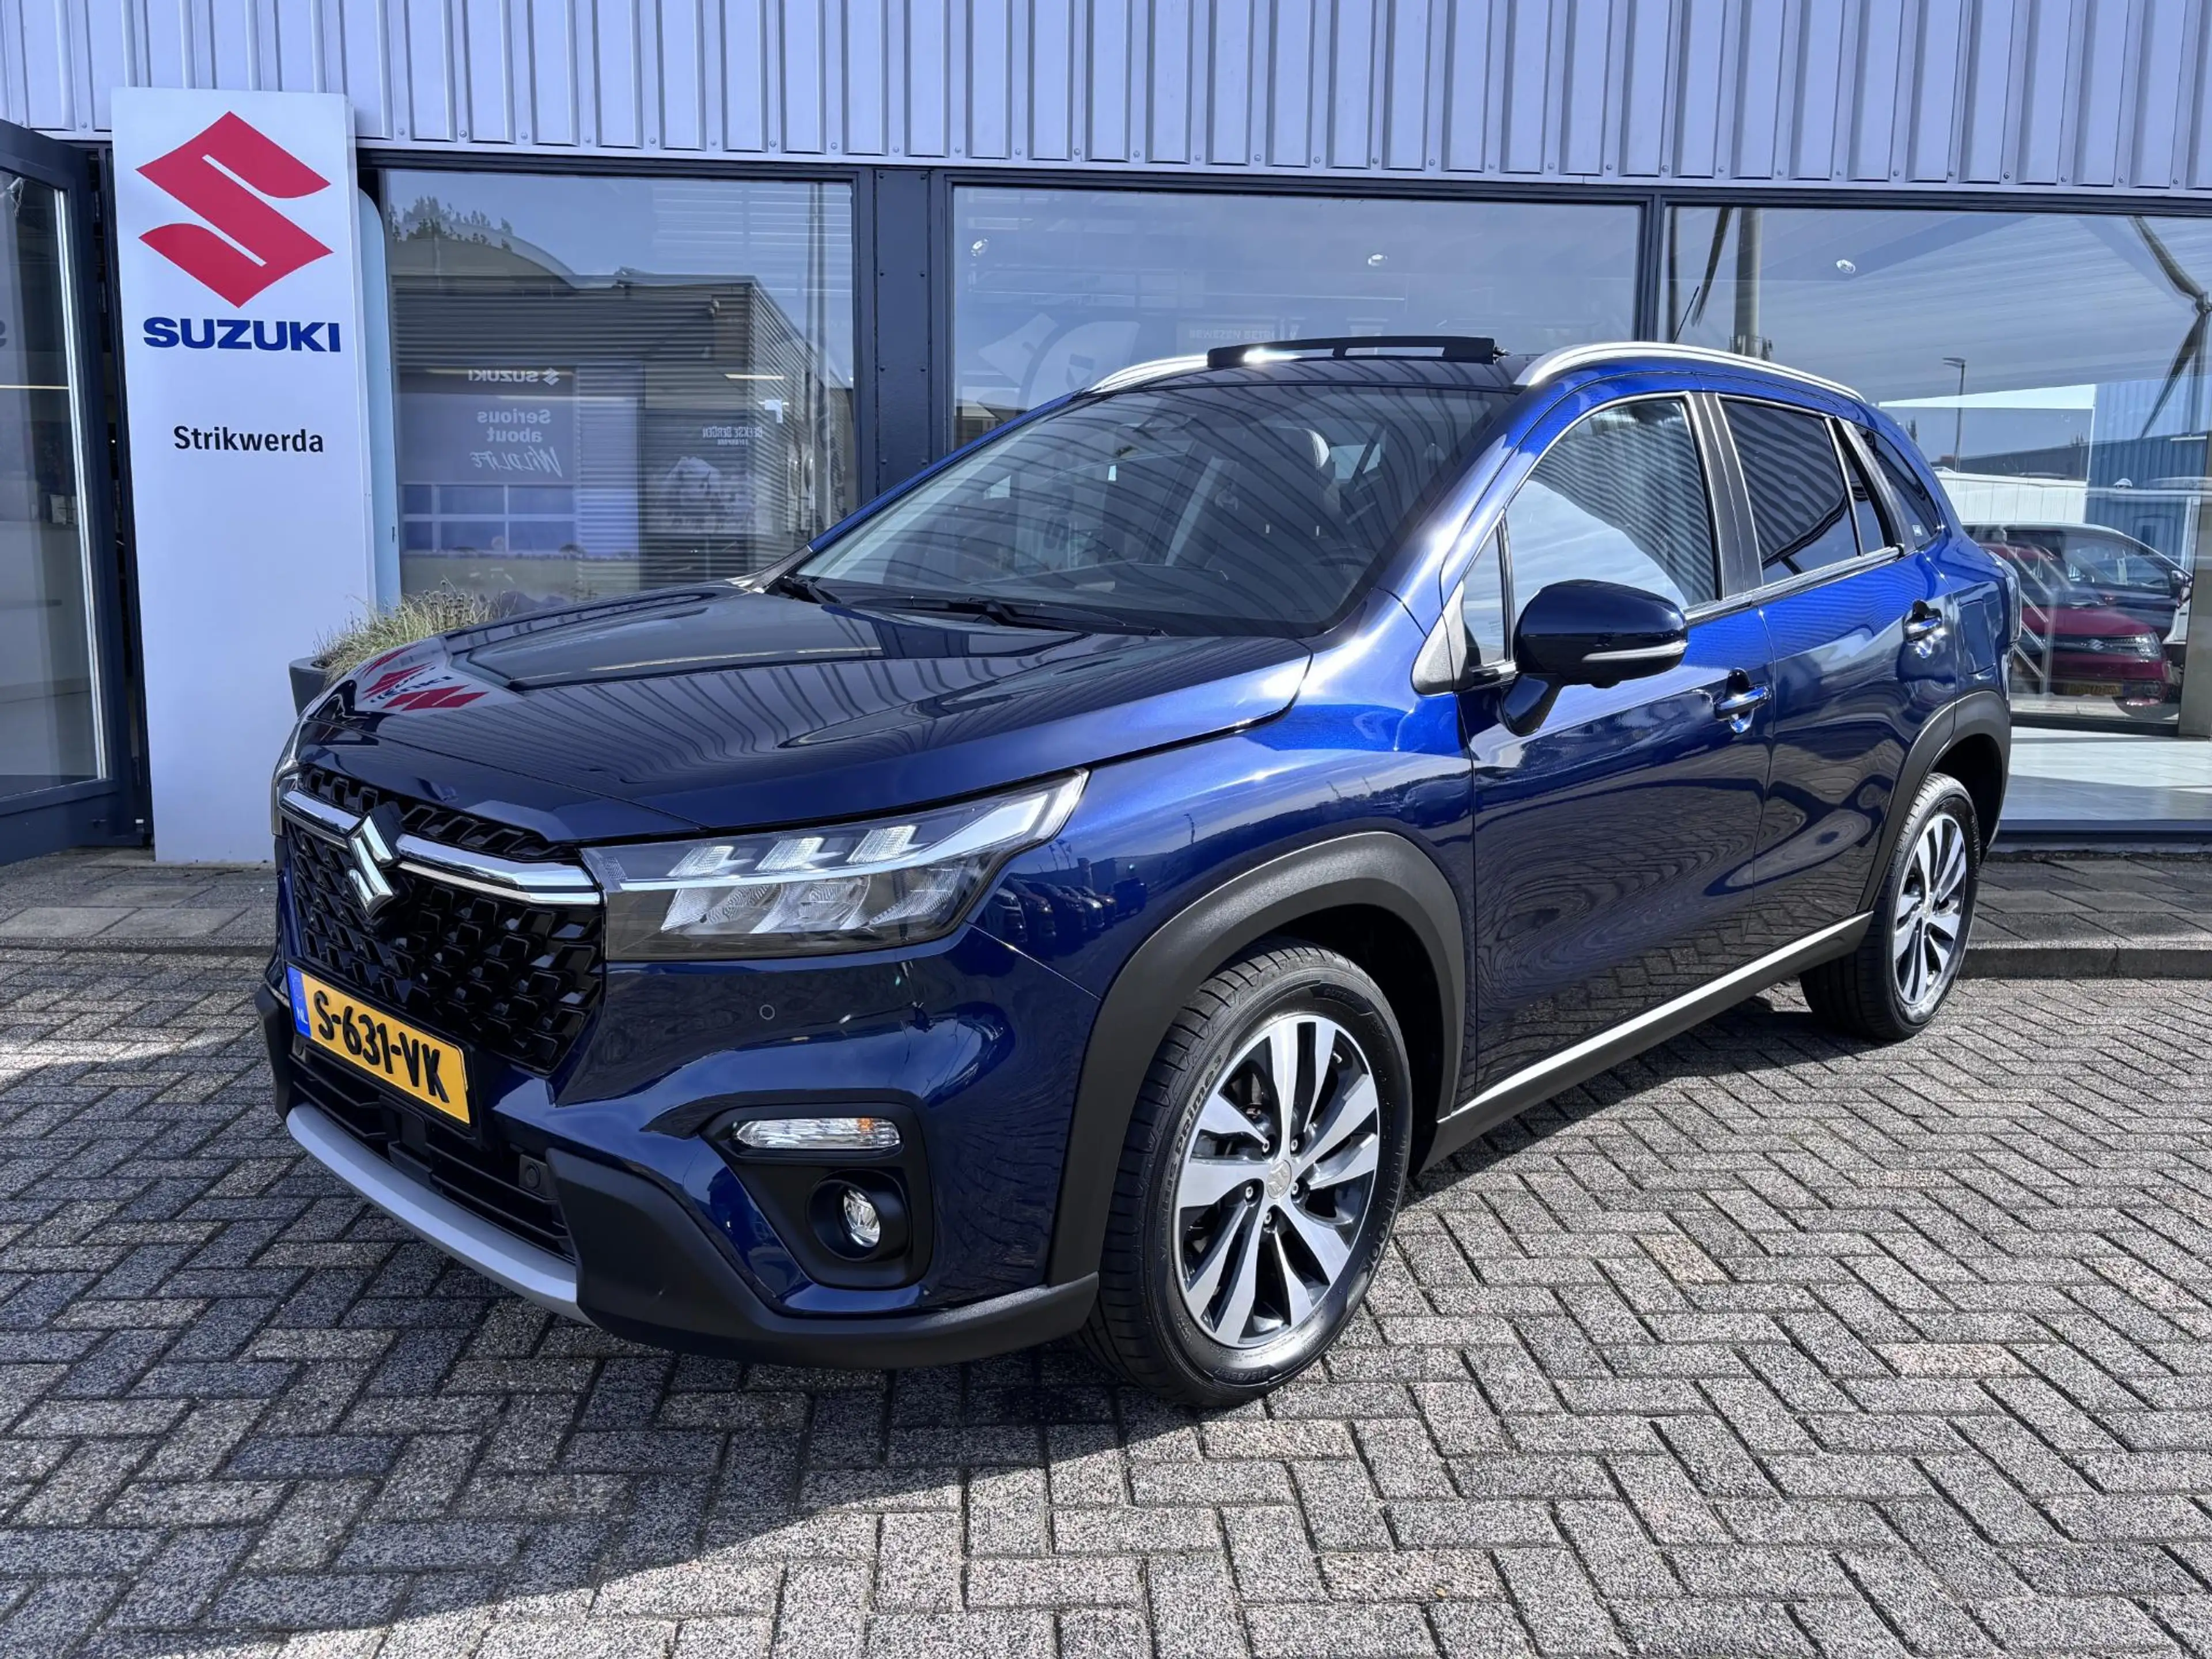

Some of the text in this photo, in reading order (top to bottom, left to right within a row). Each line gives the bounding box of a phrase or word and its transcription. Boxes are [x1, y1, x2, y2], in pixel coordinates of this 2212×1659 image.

[143, 317, 341, 353] SUZUKI
[173, 425, 324, 453] Strikwerda
[313, 990, 450, 1103] S-631-VK
